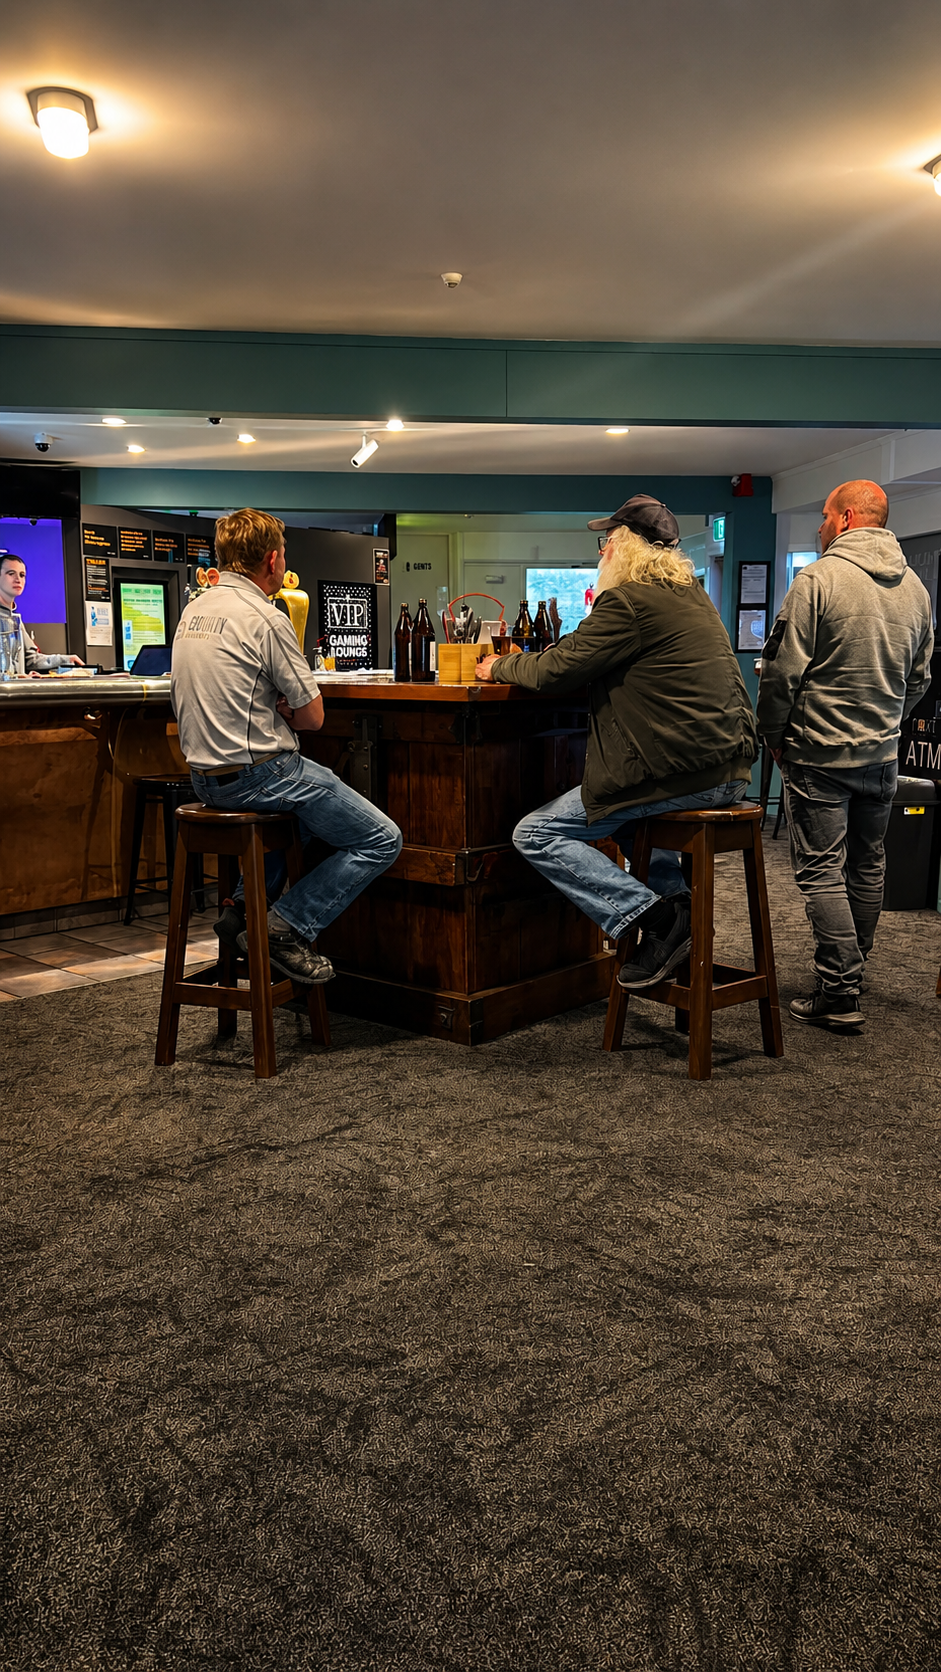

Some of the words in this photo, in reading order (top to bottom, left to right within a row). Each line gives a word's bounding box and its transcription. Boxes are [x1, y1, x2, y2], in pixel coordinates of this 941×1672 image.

[329, 603, 364, 626] VIP
[329, 634, 368, 647] GAMING
[905, 740, 941, 770] ATM
